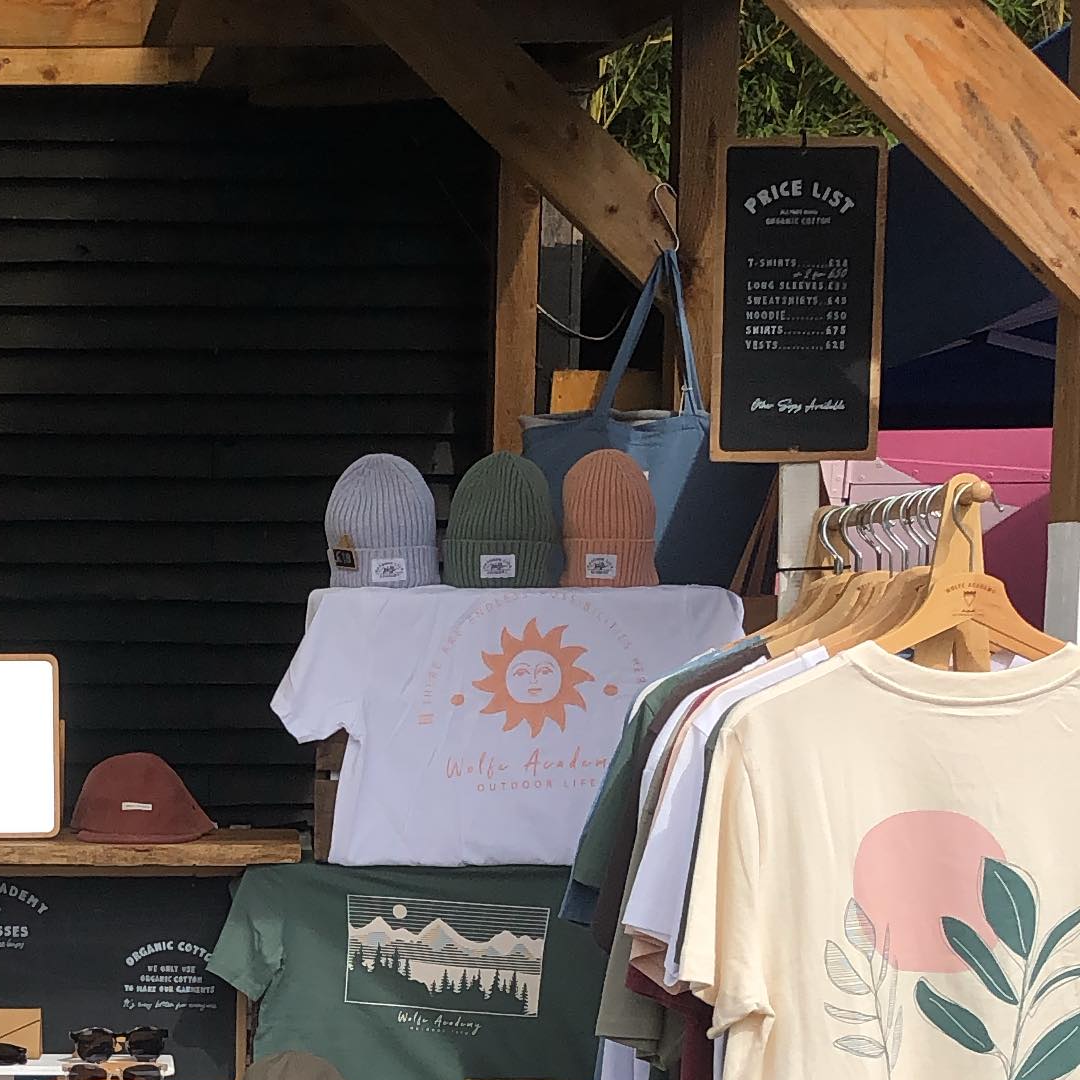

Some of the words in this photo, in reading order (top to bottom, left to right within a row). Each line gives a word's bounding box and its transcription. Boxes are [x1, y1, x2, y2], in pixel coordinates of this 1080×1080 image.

[744, 179, 802, 214] PRICE
[812, 181, 855, 213] LIST
[747, 280, 775, 291] LONG
[524, 745, 608, 777] Academ
[477, 779, 553, 793] OUTDOOR
[563, 778, 597, 788] LIFE
[125, 941, 174, 967] ORGANIC
[177, 942, 213, 962] COTTO
[140, 975, 172, 983] ORGANIC
[173, 976, 203, 984] COTTON
